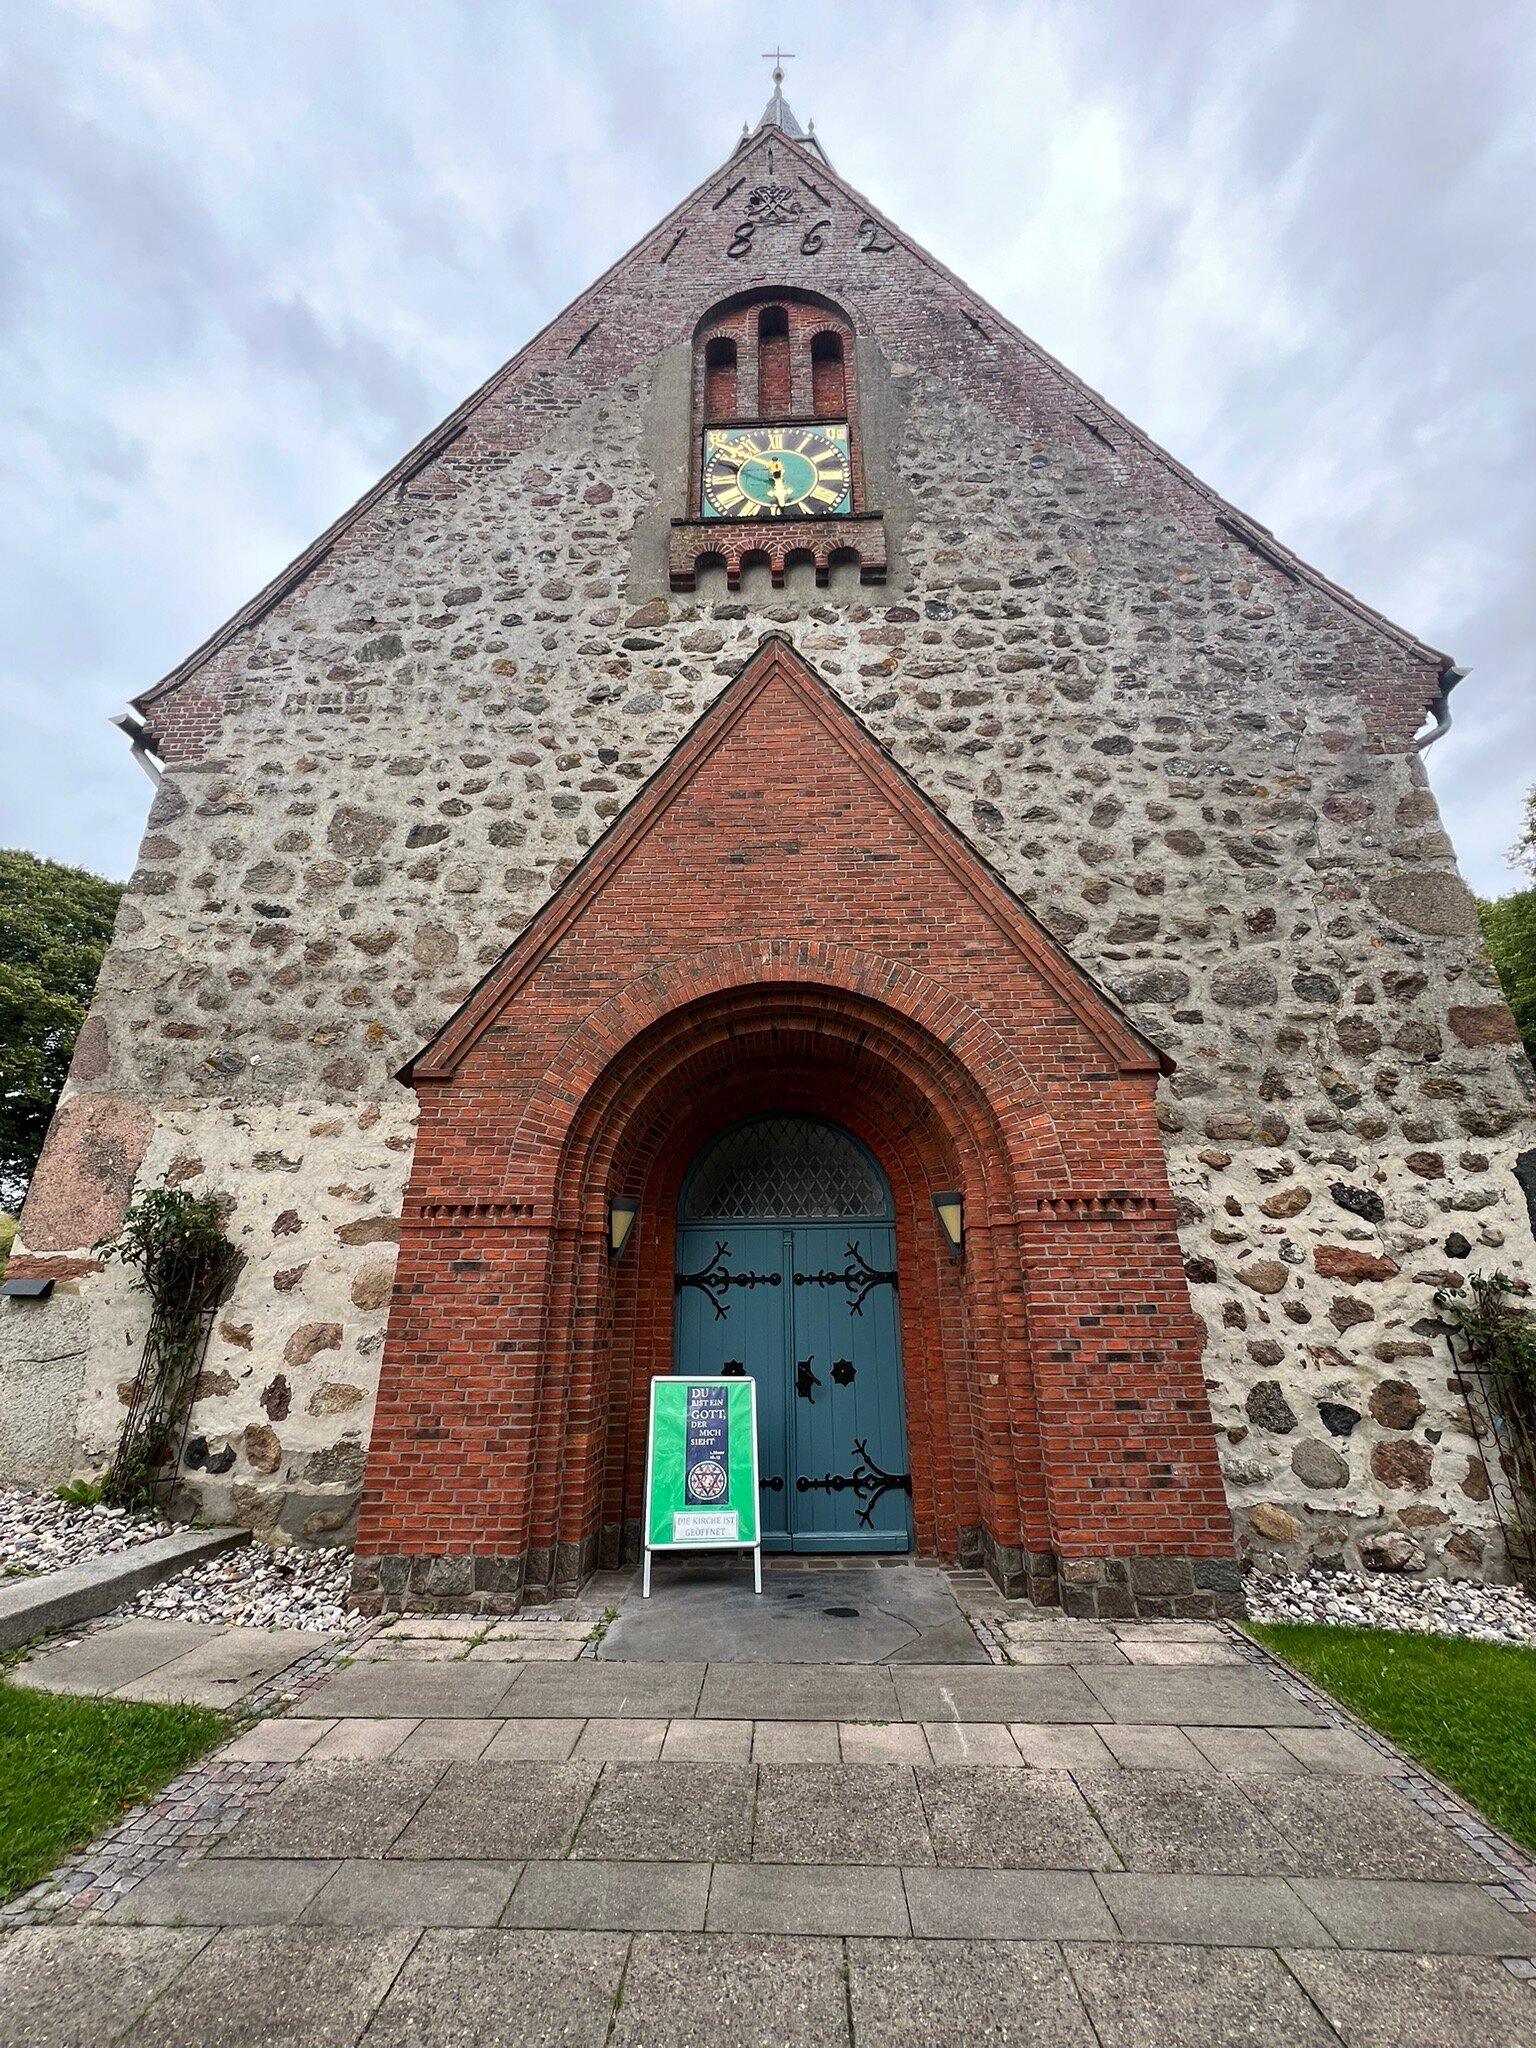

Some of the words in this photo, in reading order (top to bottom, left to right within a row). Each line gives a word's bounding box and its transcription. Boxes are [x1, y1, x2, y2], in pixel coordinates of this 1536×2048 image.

[660, 218, 895, 263] 1862
[768, 434, 783, 450] XII
[691, 1388, 709, 1398] DU
[691, 1399, 708, 1407] BIST
[691, 1409, 726, 1420] GOTT,
[699, 1429, 721, 1437] MICH
[690, 1438, 715, 1446] SIEHT
[677, 1517, 690, 1525] DIE
[692, 1516, 721, 1525] KIRCHE
[723, 1516, 734, 1524] IST
